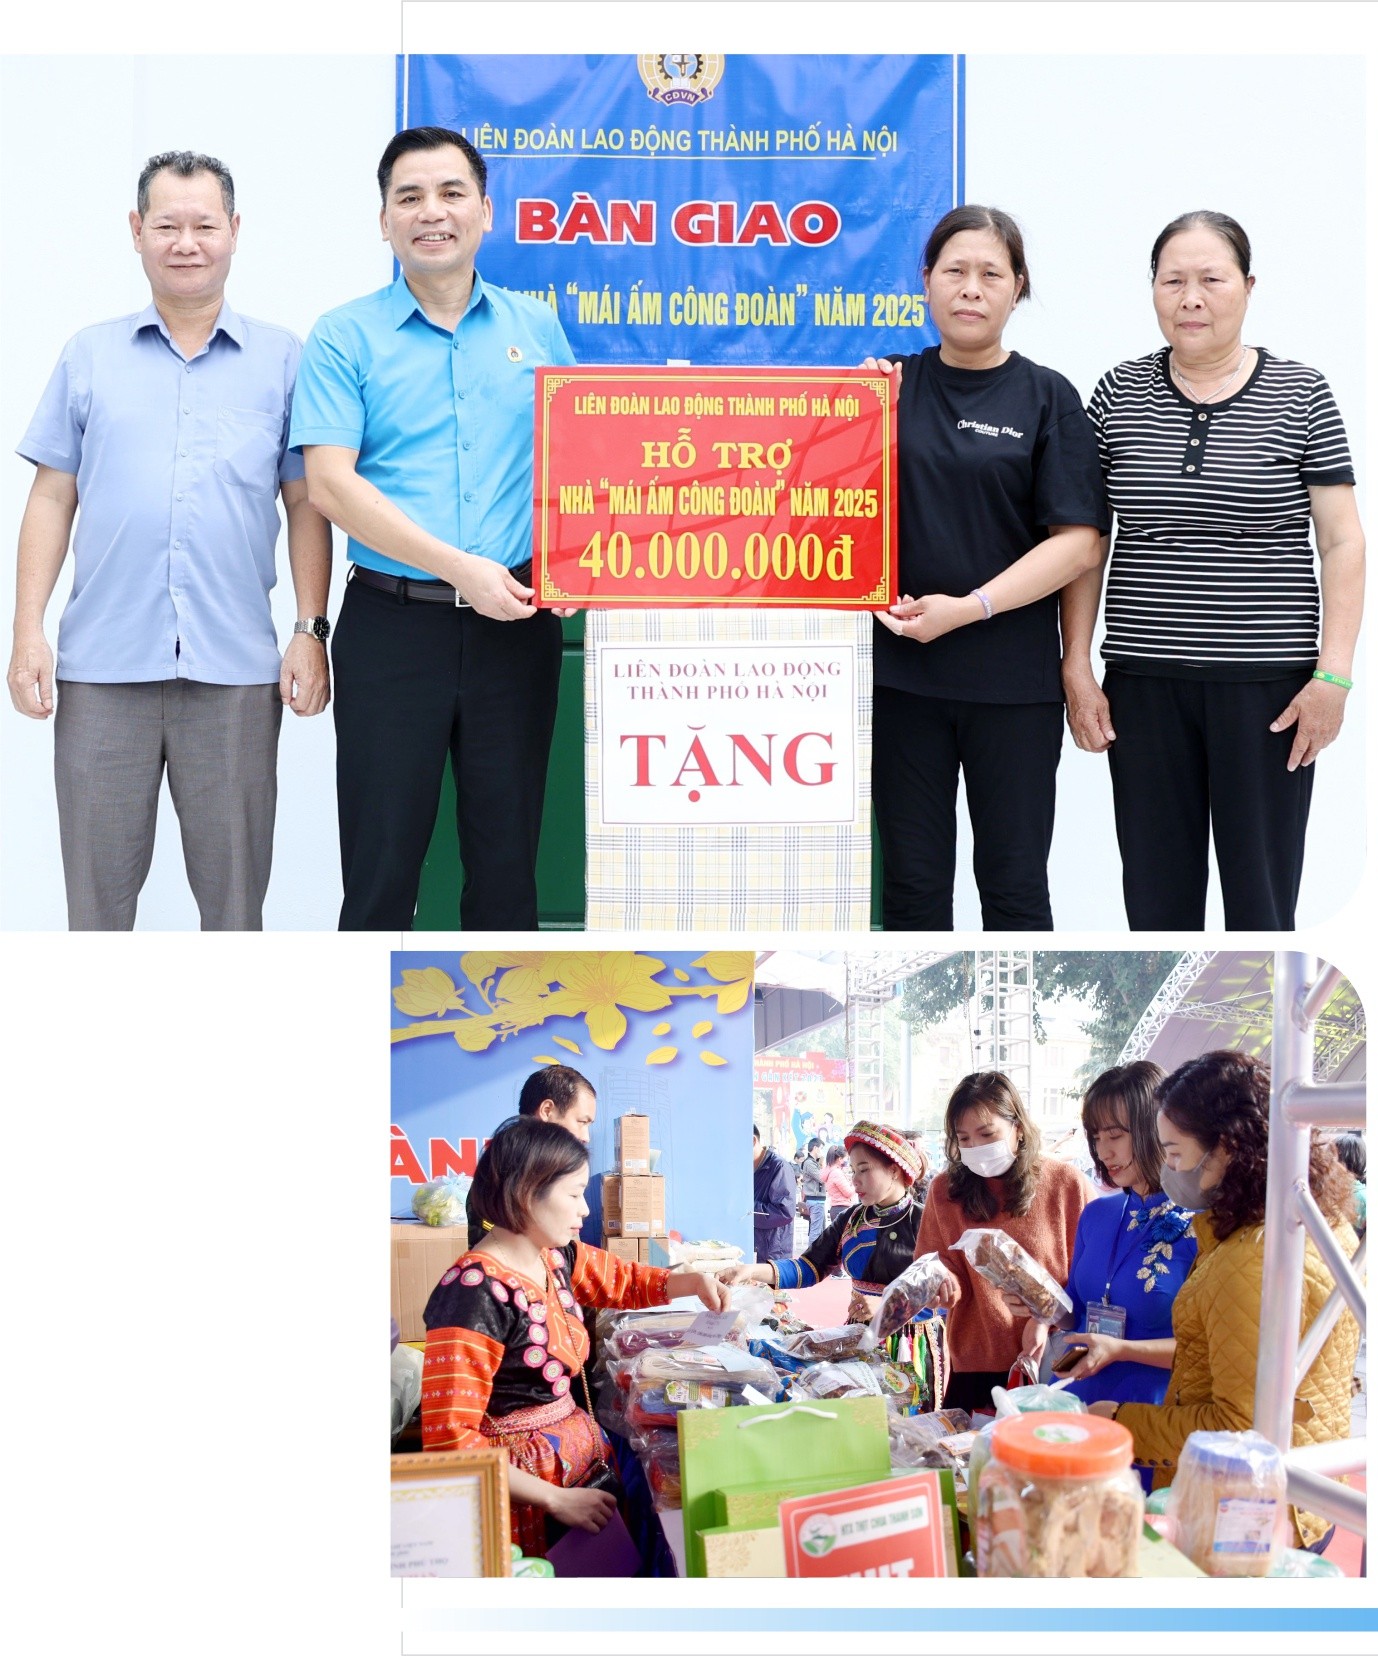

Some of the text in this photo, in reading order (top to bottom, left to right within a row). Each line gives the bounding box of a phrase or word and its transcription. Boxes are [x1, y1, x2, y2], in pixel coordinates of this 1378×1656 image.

[514, 122, 574, 150] ĐOÀN
[581, 128, 624, 151] LAO
[630, 124, 691, 158] ĐỘNG
[698, 122, 769, 152] THÀNH
[776, 121, 822, 152] PHỐ
[827, 123, 857, 151] HÀ
[863, 125, 898, 158] NỘI
[514, 191, 842, 248] BÀN GIAO
[627, 280, 662, 325] ẤM
[669, 283, 727, 326] CÔNG
[735, 283, 808, 326] ĐOÀN”
[815, 286, 866, 327] NĂM
[872, 292, 926, 328] 2025
[575, 390, 860, 421] LIÊN ĐOÀN LAO ĐỘNG THÀNH PHỐ HÀ NỘI
[957, 419, 1024, 439] Christian Dior
[641, 427, 793, 477] HỖ TRỢ
[559, 478, 878, 519] NHÀ “MÁI ẤM CÔNG ĐOÀN” NĂM 2025
[578, 530, 855, 582] 40.000.000đ
[614, 658, 841, 680] LIÊN ĐOÀN LAO ĐỘNG
[627, 680, 827, 702] THÀNH PHỐ HÀ NỘI
[620, 724, 839, 803] TẶNG
